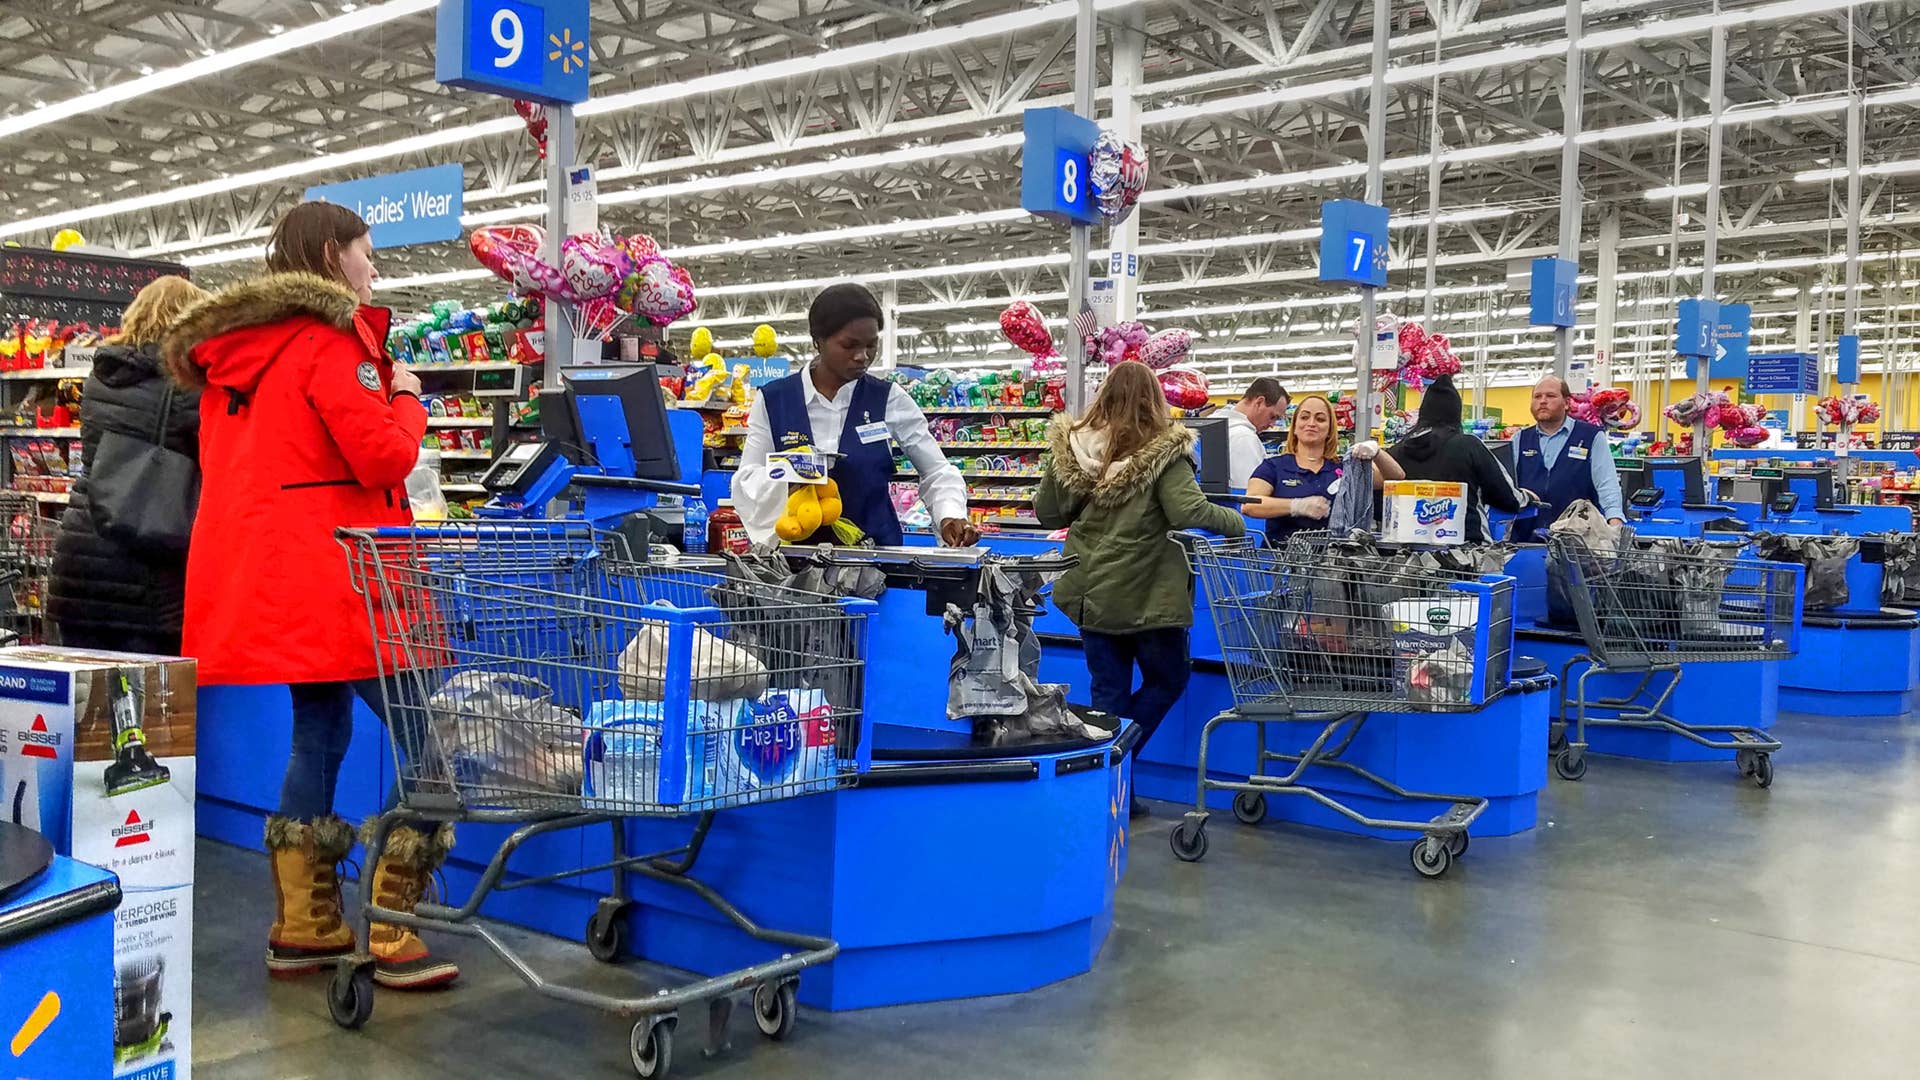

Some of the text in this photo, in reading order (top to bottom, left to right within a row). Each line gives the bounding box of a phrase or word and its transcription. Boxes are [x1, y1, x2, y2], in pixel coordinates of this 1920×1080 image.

[490, 8, 524, 68] 9
[1062, 158, 1078, 204] 8
[411, 189, 452, 220] Wear
[1352, 237, 1367, 272] 7
[1557, 289, 1565, 317] 6
[1701, 324, 1708, 348] 5
[765, 366, 785, 378] Wear
[1420, 498, 1449, 518] Scott
[125, 917, 148, 928] TURBO
[149, 910, 177, 922] REWIND
